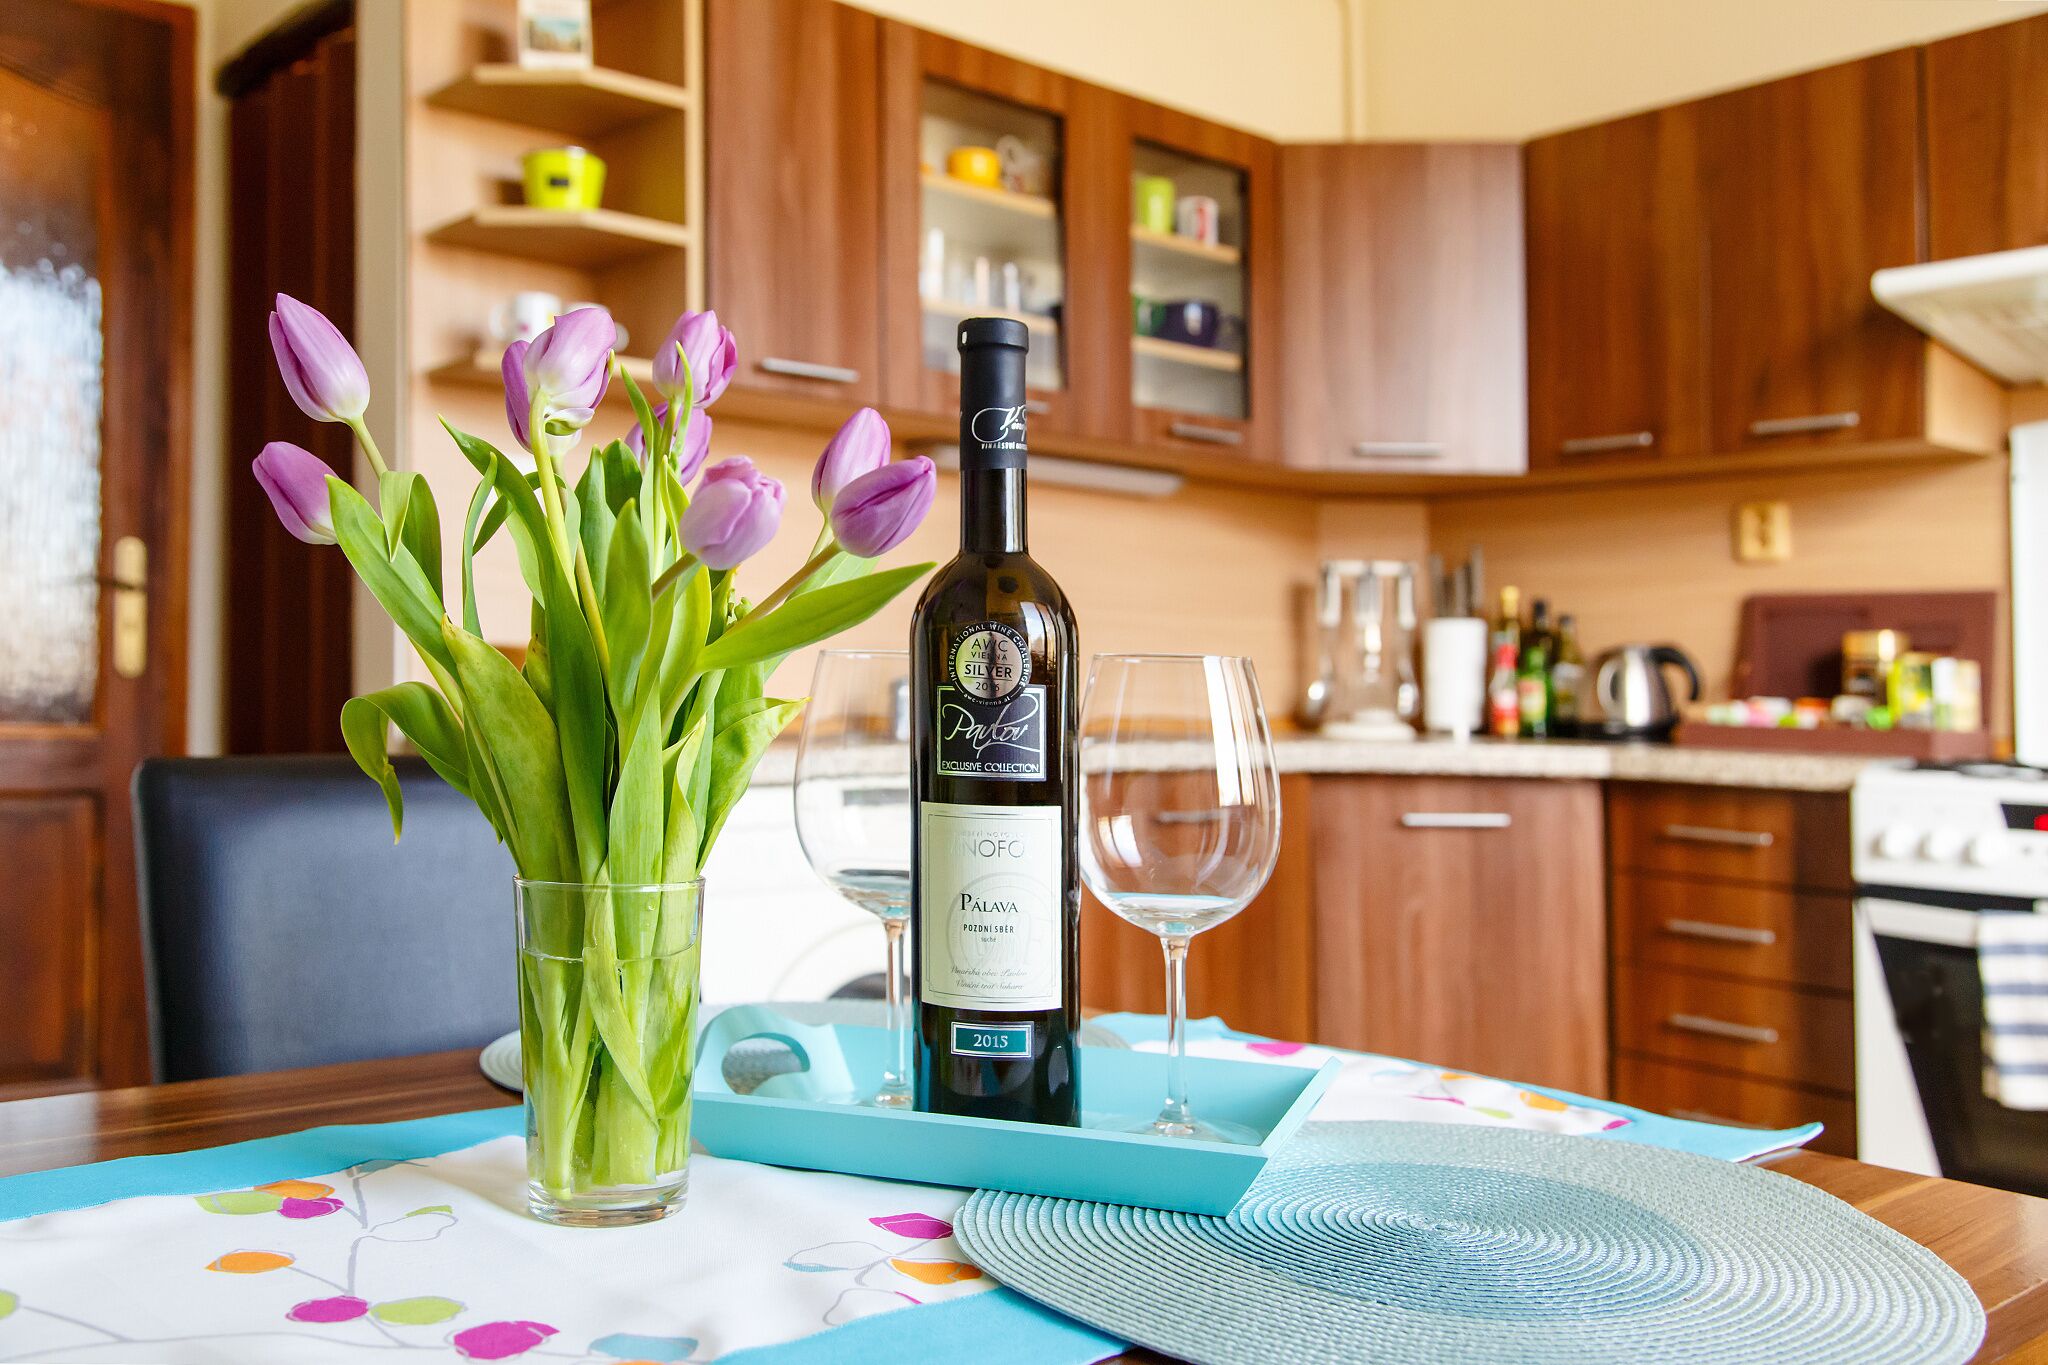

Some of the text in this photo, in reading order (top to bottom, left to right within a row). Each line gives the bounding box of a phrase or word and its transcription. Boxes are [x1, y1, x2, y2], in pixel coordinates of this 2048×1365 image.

[972, 638, 1008, 652] AWC
[949, 623, 1030, 687] INTERNATIONAL WINE CHALLENGE
[965, 664, 1012, 678] SILVER
[976, 682, 999, 691] 206
[942, 761, 1039, 773] EXCLUSIVE COLLECTION
[973, 1034, 1008, 1049] 2015
